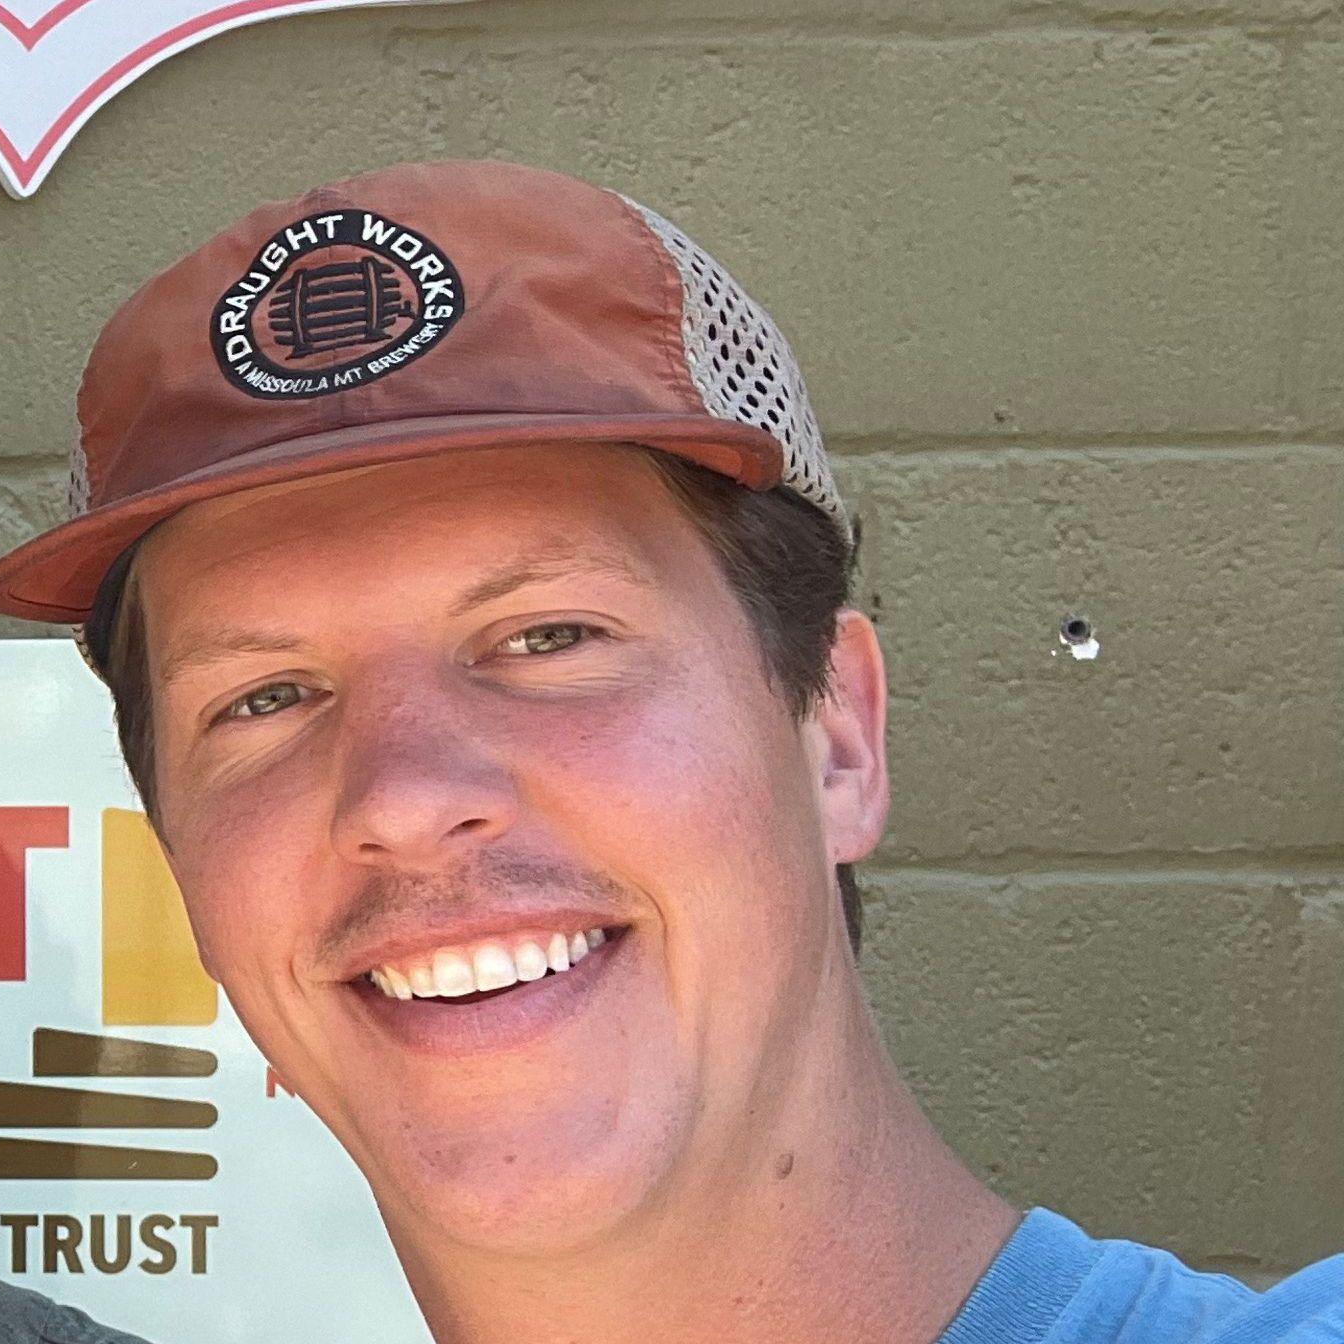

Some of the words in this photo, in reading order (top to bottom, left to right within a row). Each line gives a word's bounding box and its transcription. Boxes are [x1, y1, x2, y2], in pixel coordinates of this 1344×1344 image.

[220, 214, 343, 362] DRAUGHT
[362, 214, 454, 320] WORKS
[235, 361, 252, 375] A
[244, 366, 329, 393] MISSOULA
[334, 367, 363, 388] MT
[367, 322, 443, 373] BREWERY
[0, 1213, 219, 1275] TRUST
